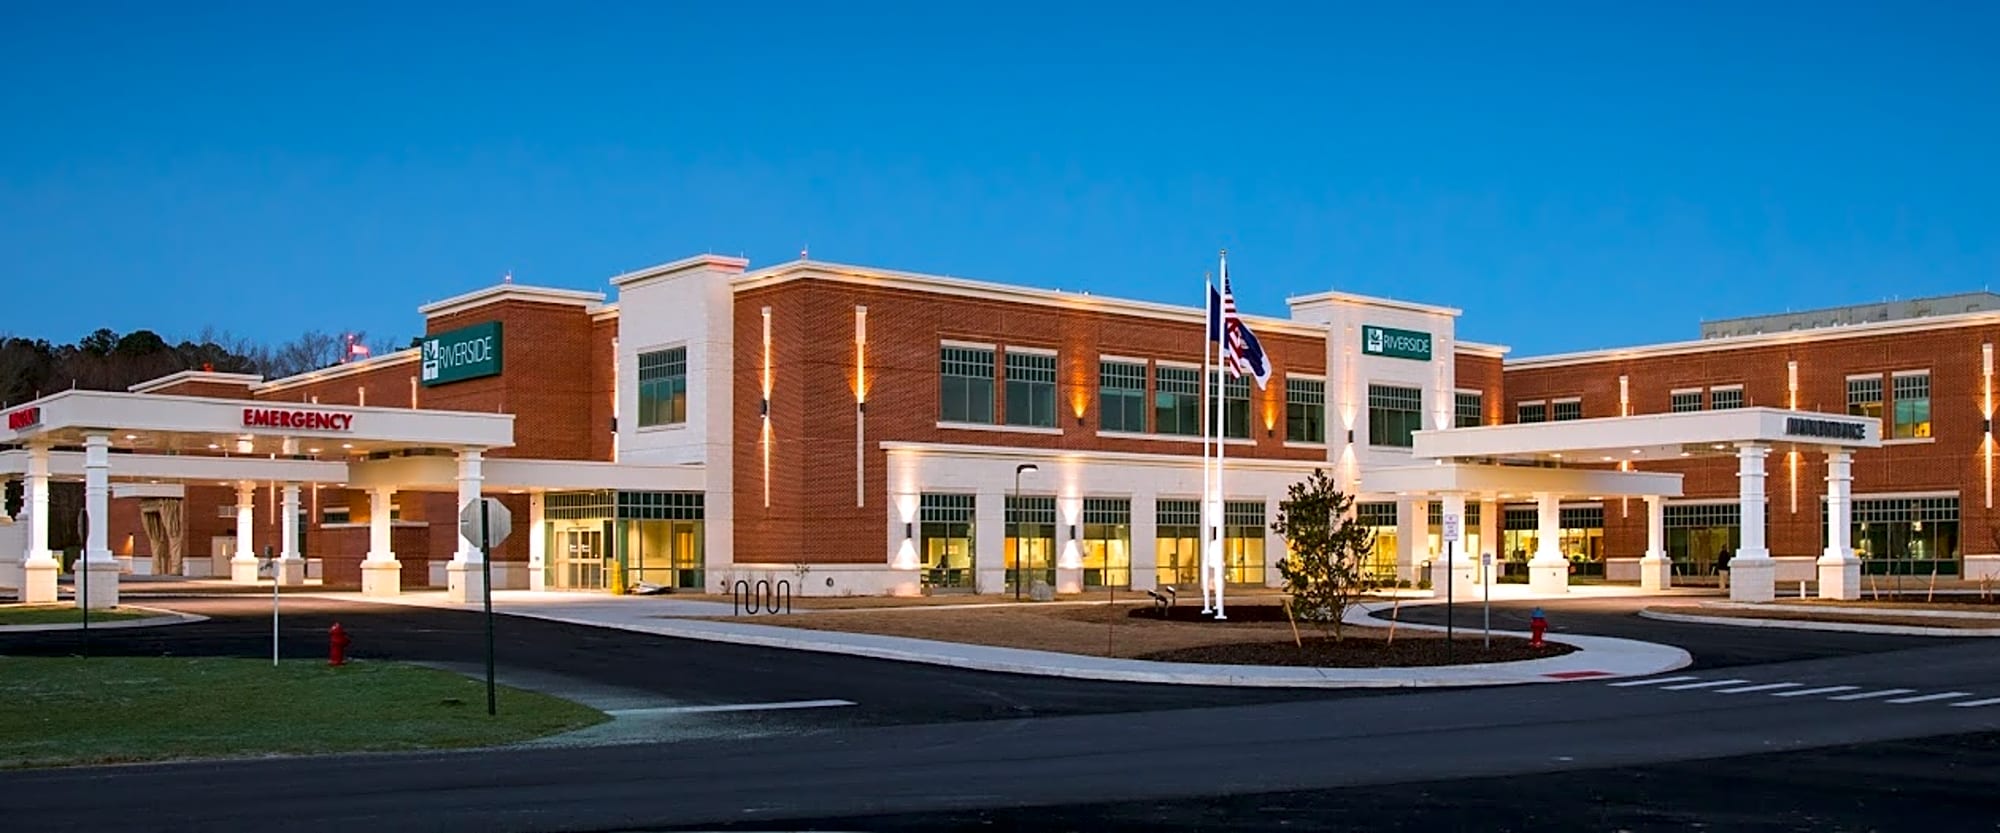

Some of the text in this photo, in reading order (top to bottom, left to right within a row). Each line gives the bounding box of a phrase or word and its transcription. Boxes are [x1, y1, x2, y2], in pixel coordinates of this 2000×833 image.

[440, 336, 492, 369] RIVERSIDE
[1384, 335, 1430, 353] RIVERSIDE
[243, 408, 353, 429] EMERGENCY
